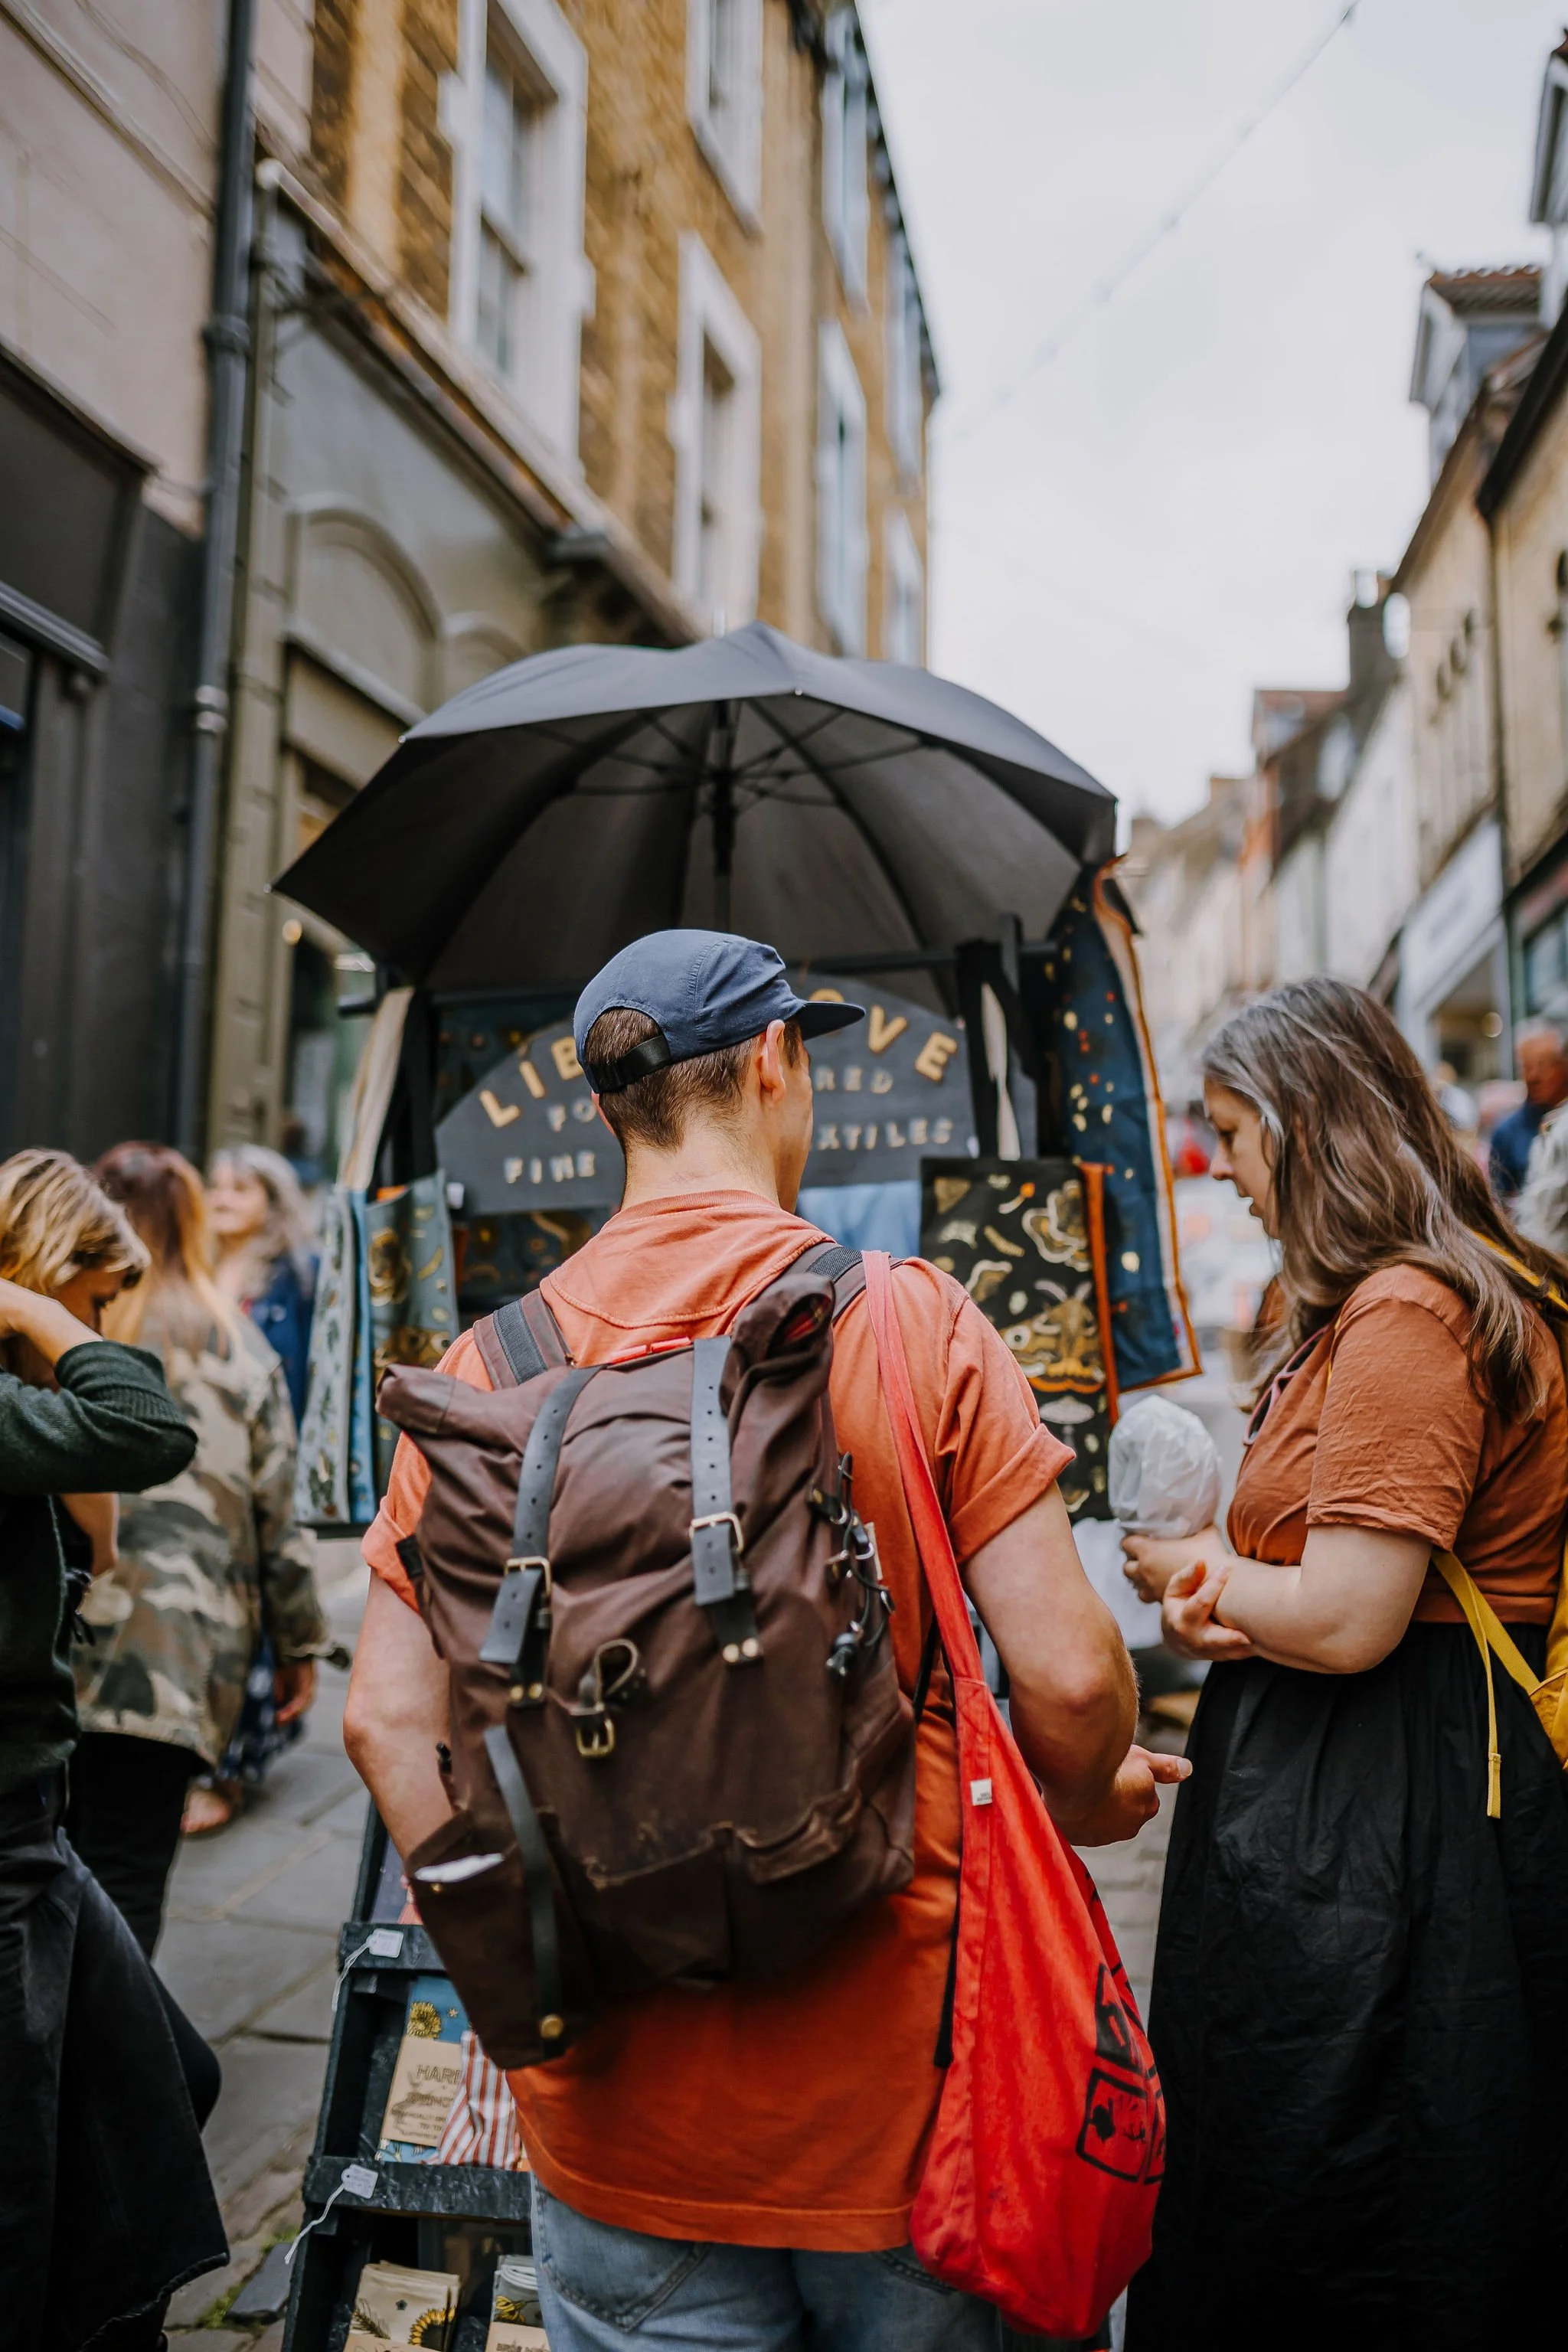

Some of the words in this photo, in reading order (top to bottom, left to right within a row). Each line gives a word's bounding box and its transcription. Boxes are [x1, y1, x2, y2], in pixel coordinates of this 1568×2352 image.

[479, 1037, 586, 1128] LIB
[808, 988, 957, 1082] VE
[547, 1096, 597, 1132] FO
[814, 1065, 893, 1094] RED
[503, 1150, 596, 1184] FINE
[816, 1116, 954, 1151] XTILES
